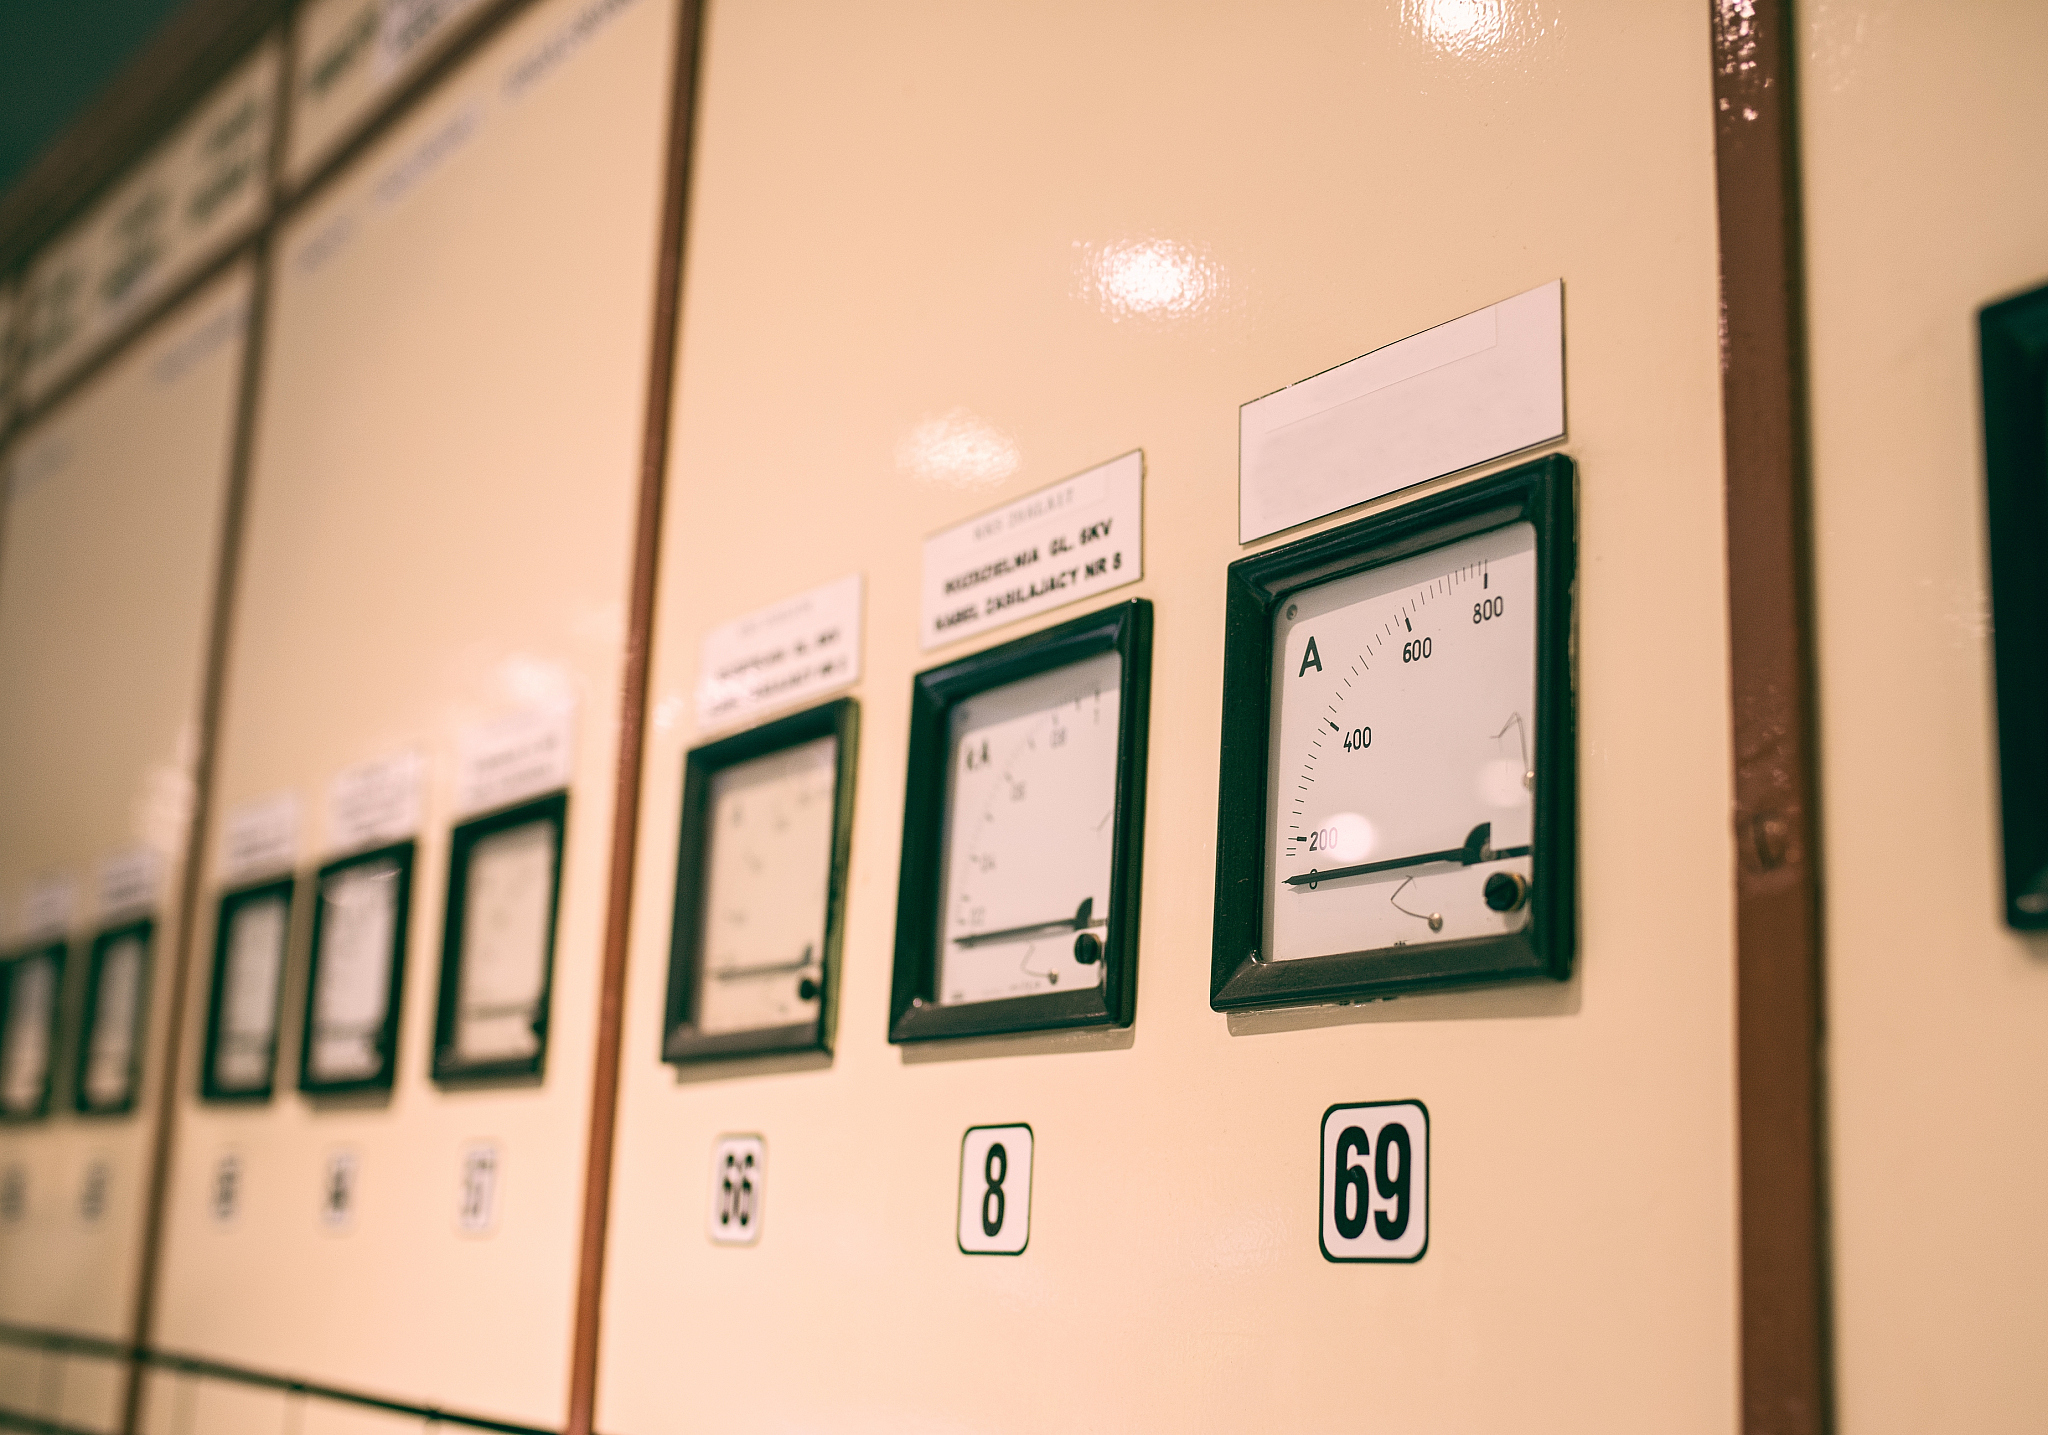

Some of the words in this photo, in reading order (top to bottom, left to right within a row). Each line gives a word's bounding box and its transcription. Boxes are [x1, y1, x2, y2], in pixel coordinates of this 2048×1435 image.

[1084, 556, 1107, 580] NR
[1473, 595, 1504, 624] 800
[1299, 635, 1323, 677] A
[1402, 636, 1432, 663] 600
[1343, 726, 1372, 753] 400
[1309, 826, 1338, 851] 200
[982, 1142, 1007, 1237] 8
[1333, 1122, 1412, 1240] 69
